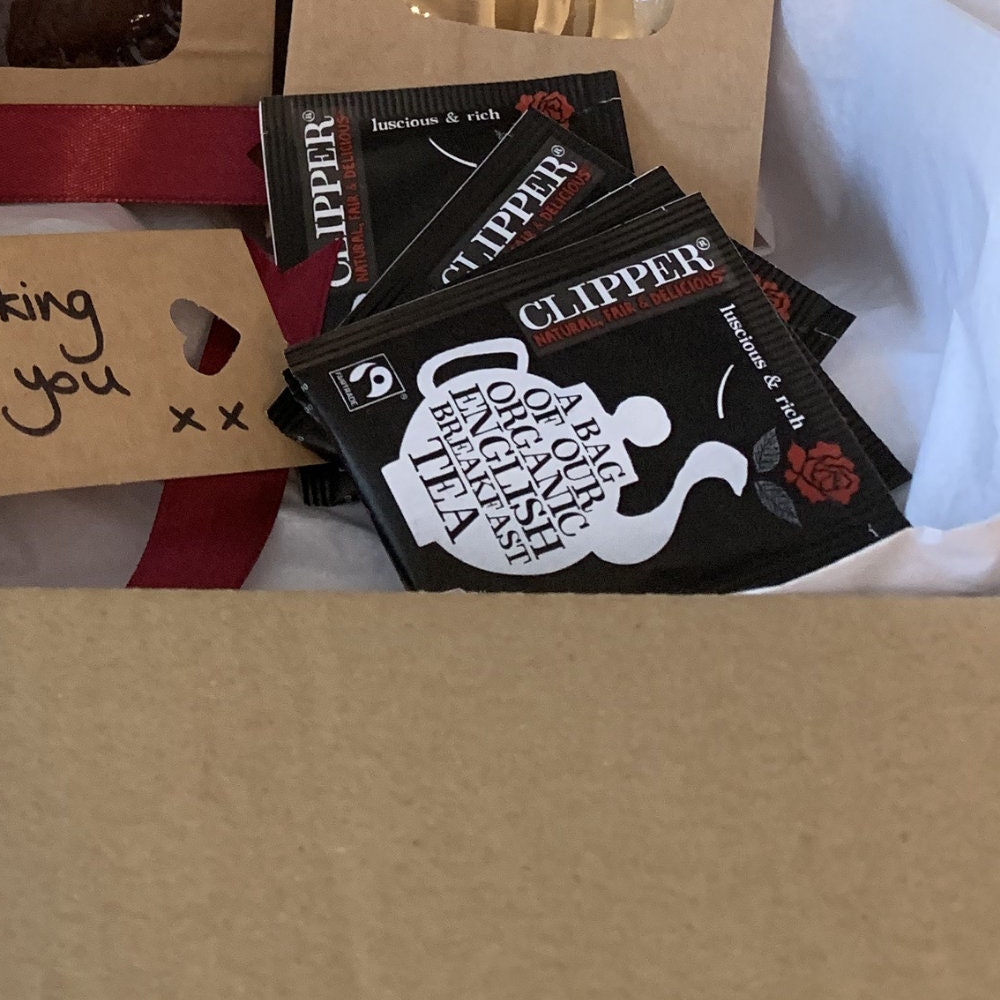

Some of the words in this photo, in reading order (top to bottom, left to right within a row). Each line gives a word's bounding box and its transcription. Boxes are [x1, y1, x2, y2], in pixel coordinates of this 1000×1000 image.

[372, 113, 439, 132] luscious
[446, 111, 460, 124] &
[467, 108, 500, 123] rich
[603, 302, 636, 323] FAIR
[650, 267, 727, 306] DELICIOUS
[1, 364, 132, 437] you
[719, 302, 768, 370] luscious
[763, 373, 782, 391] &
[775, 395, 804, 431] rich
[408, 436, 480, 545] TEA
[429, 400, 532, 566] BREAKFAST
[448, 382, 566, 560] ENGLISH
[485, 381, 590, 537] ORGANIC
[522, 387, 566, 427] OF
[550, 437, 607, 513] OUR
[553, 392, 583, 416] A
[571, 416, 627, 484] BAG
